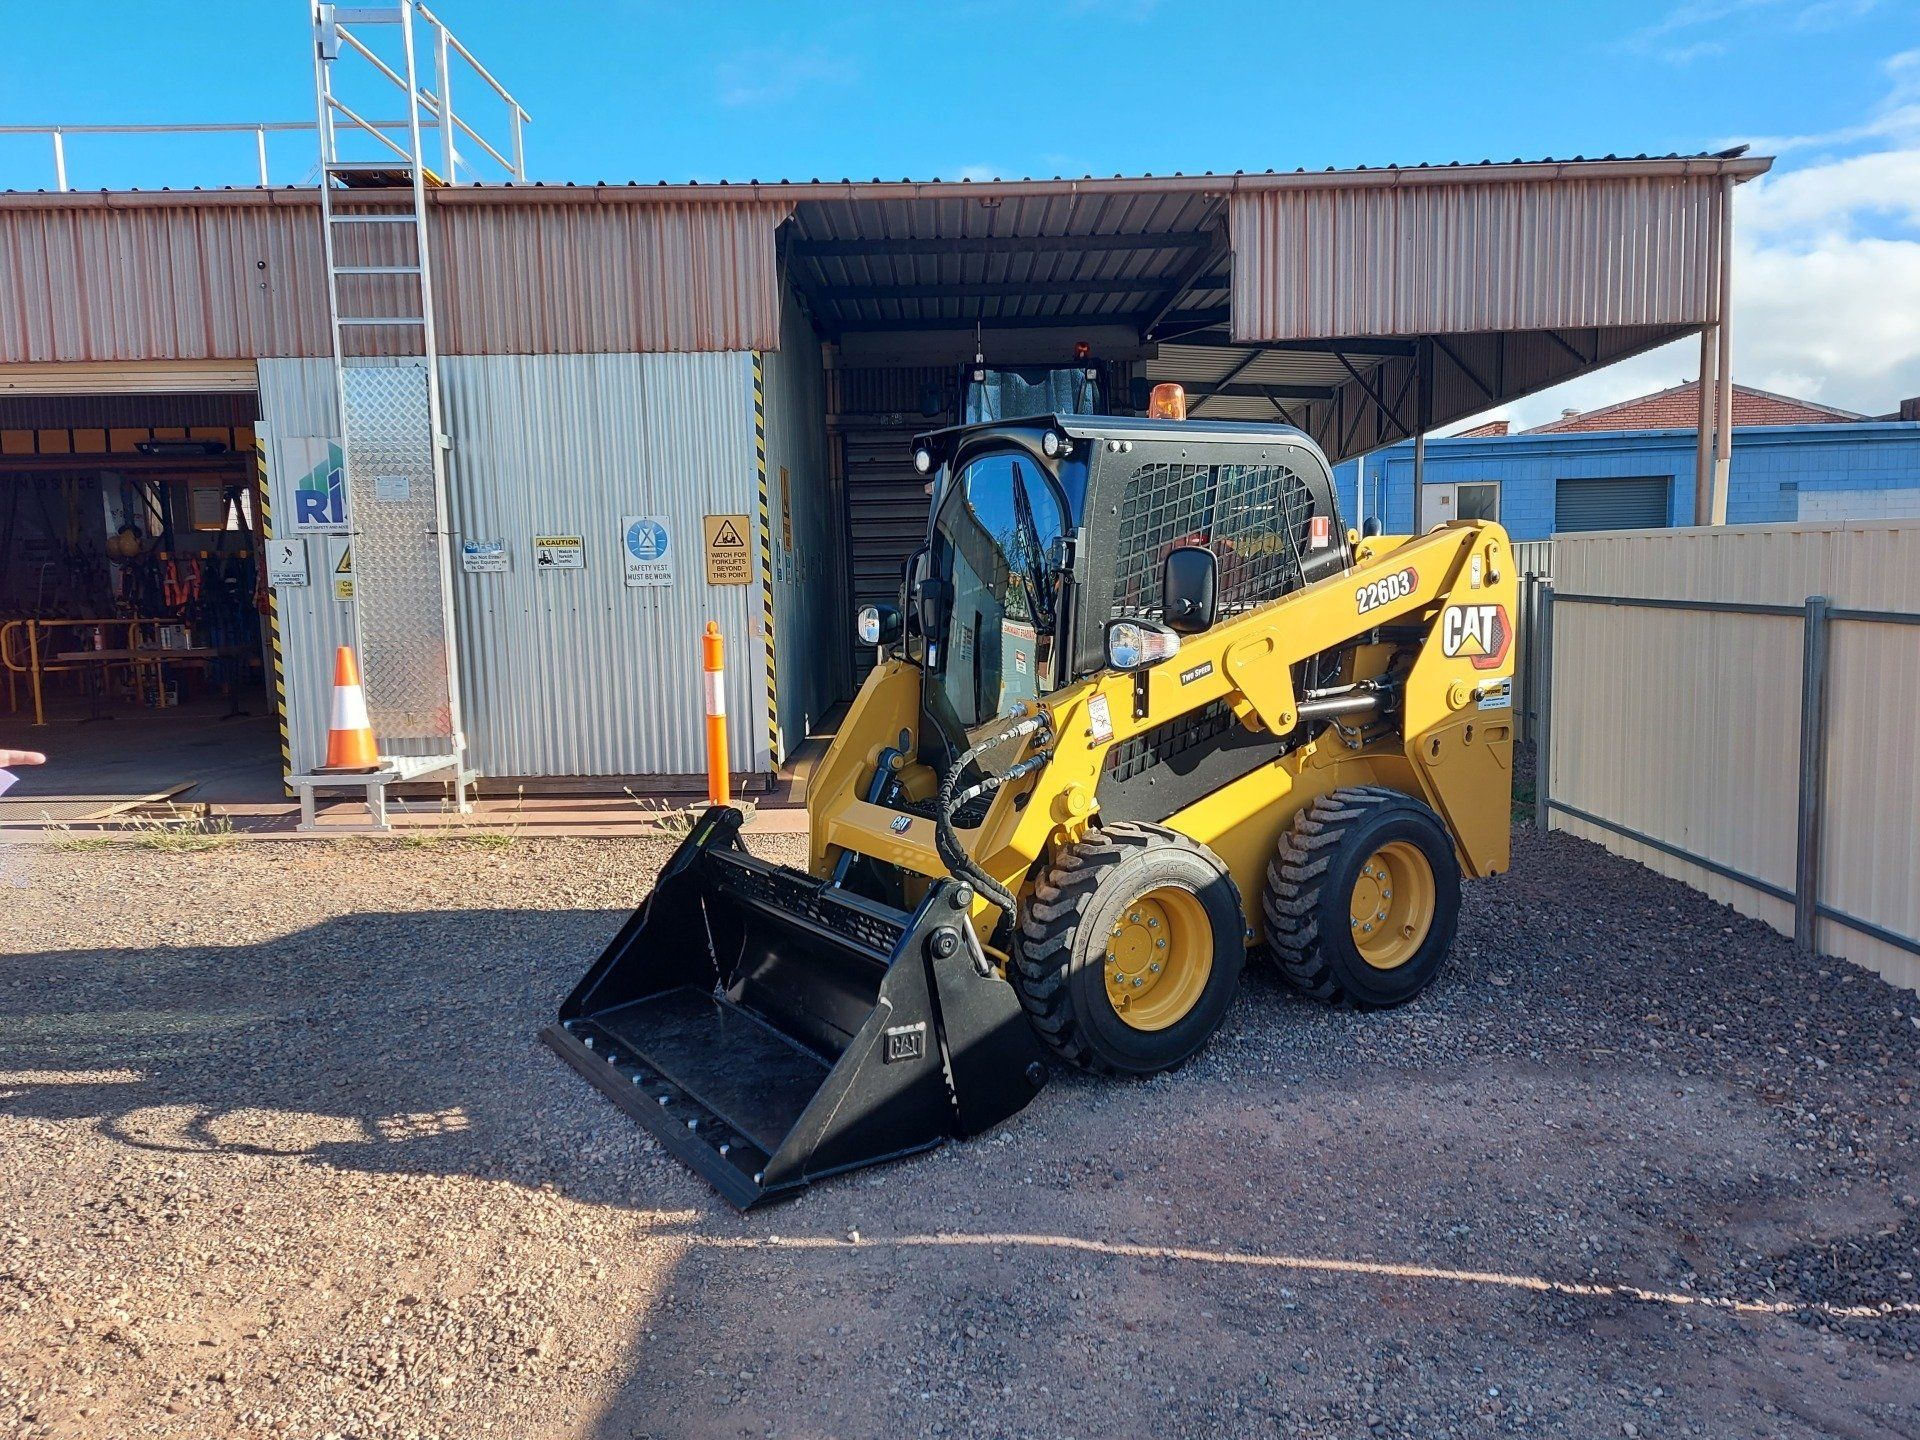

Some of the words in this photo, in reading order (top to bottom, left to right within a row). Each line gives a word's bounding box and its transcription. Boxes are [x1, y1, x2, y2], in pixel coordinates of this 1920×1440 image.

[1356, 570, 1410, 615] 226D3
[1443, 605, 1497, 657] CAT
[890, 815, 912, 831] CAT
[889, 1035, 921, 1059] CAT
